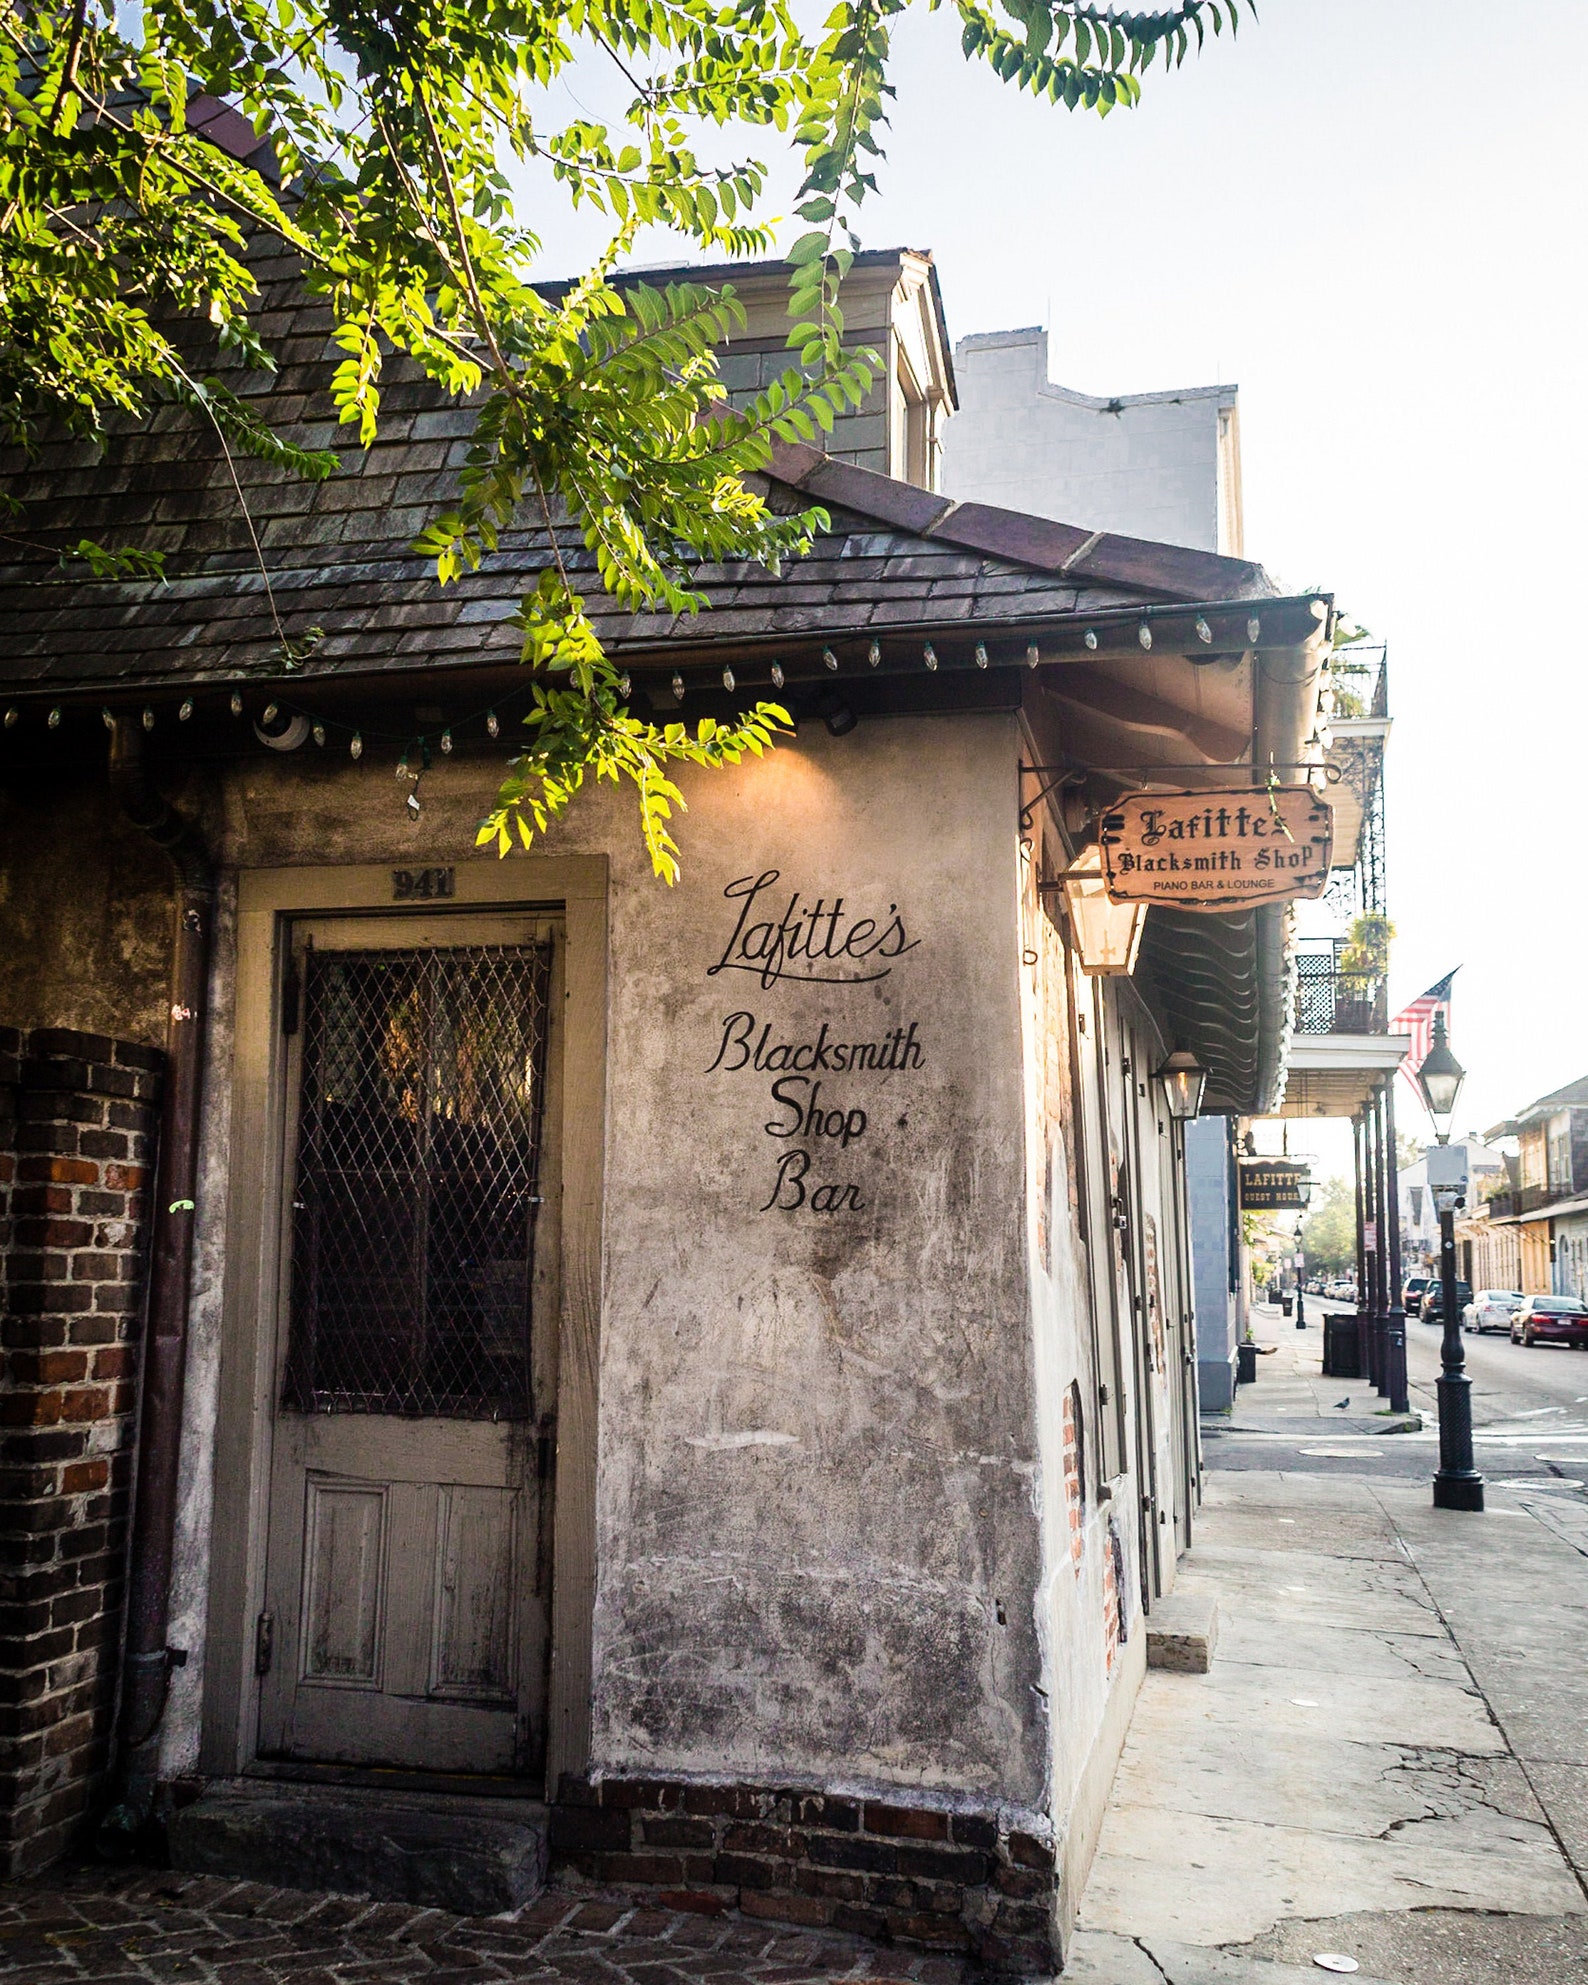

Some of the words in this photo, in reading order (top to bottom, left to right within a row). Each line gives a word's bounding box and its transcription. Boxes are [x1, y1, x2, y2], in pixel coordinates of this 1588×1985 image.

[1140, 807, 1288, 846] Lafitte's
[1118, 850, 1241, 875] Blacksmith
[1254, 845, 1312, 870] Shop
[1153, 881, 1188, 891] PIANO
[1191, 880, 1214, 890] BAR
[1216, 880, 1225, 890] &
[1227, 878, 1275, 889] LOUNGE
[707, 869, 921, 989] Lafitte's
[704, 1011, 926, 1073] Blacksmith
[765, 1075, 867, 1148] Shop
[760, 1149, 865, 1212] Bar
